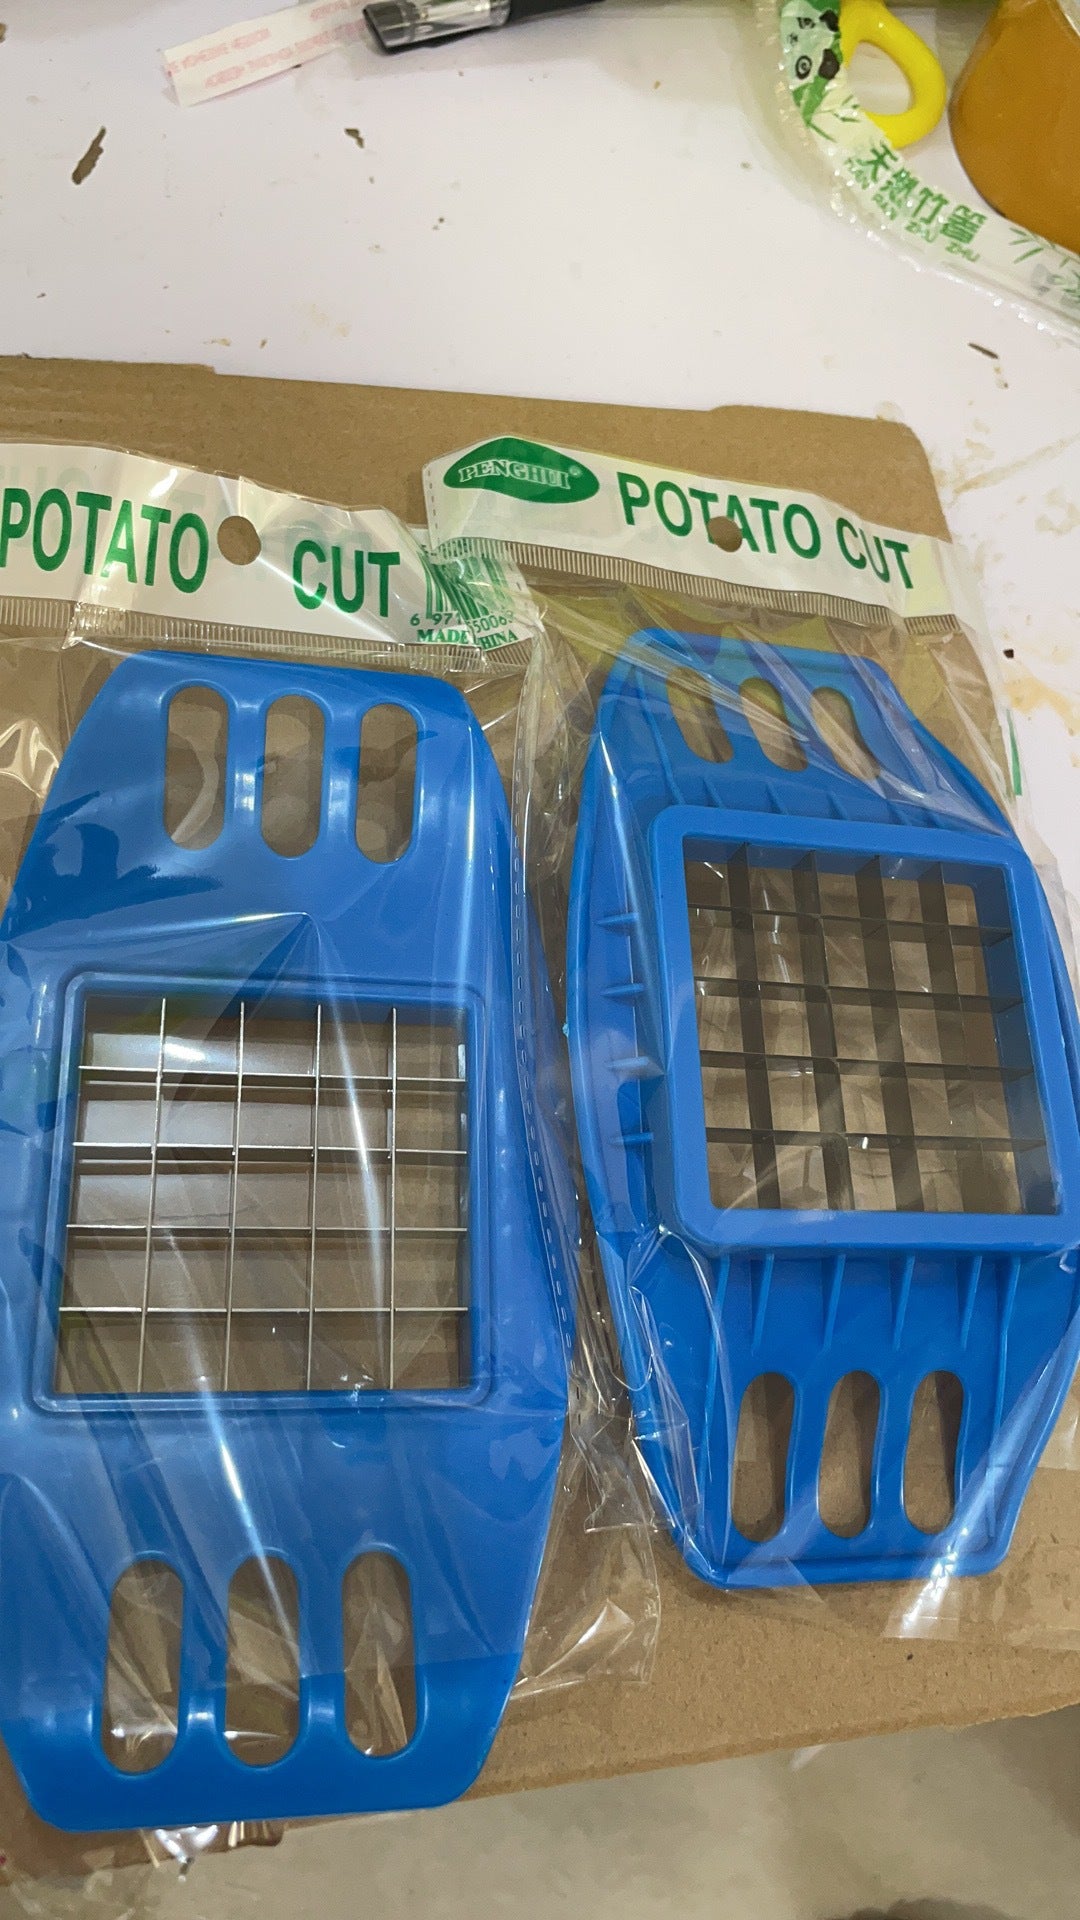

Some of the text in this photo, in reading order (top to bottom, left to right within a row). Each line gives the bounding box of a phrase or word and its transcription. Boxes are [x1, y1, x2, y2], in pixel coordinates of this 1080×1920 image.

[945, 241, 980, 262] ZHU
[458, 458, 572, 491] PENGHUI
[616, 472, 914, 589] POTATO CUT
[0, 488, 401, 617] POTATO CUT
[417, 628, 519, 650] MADE HINA
